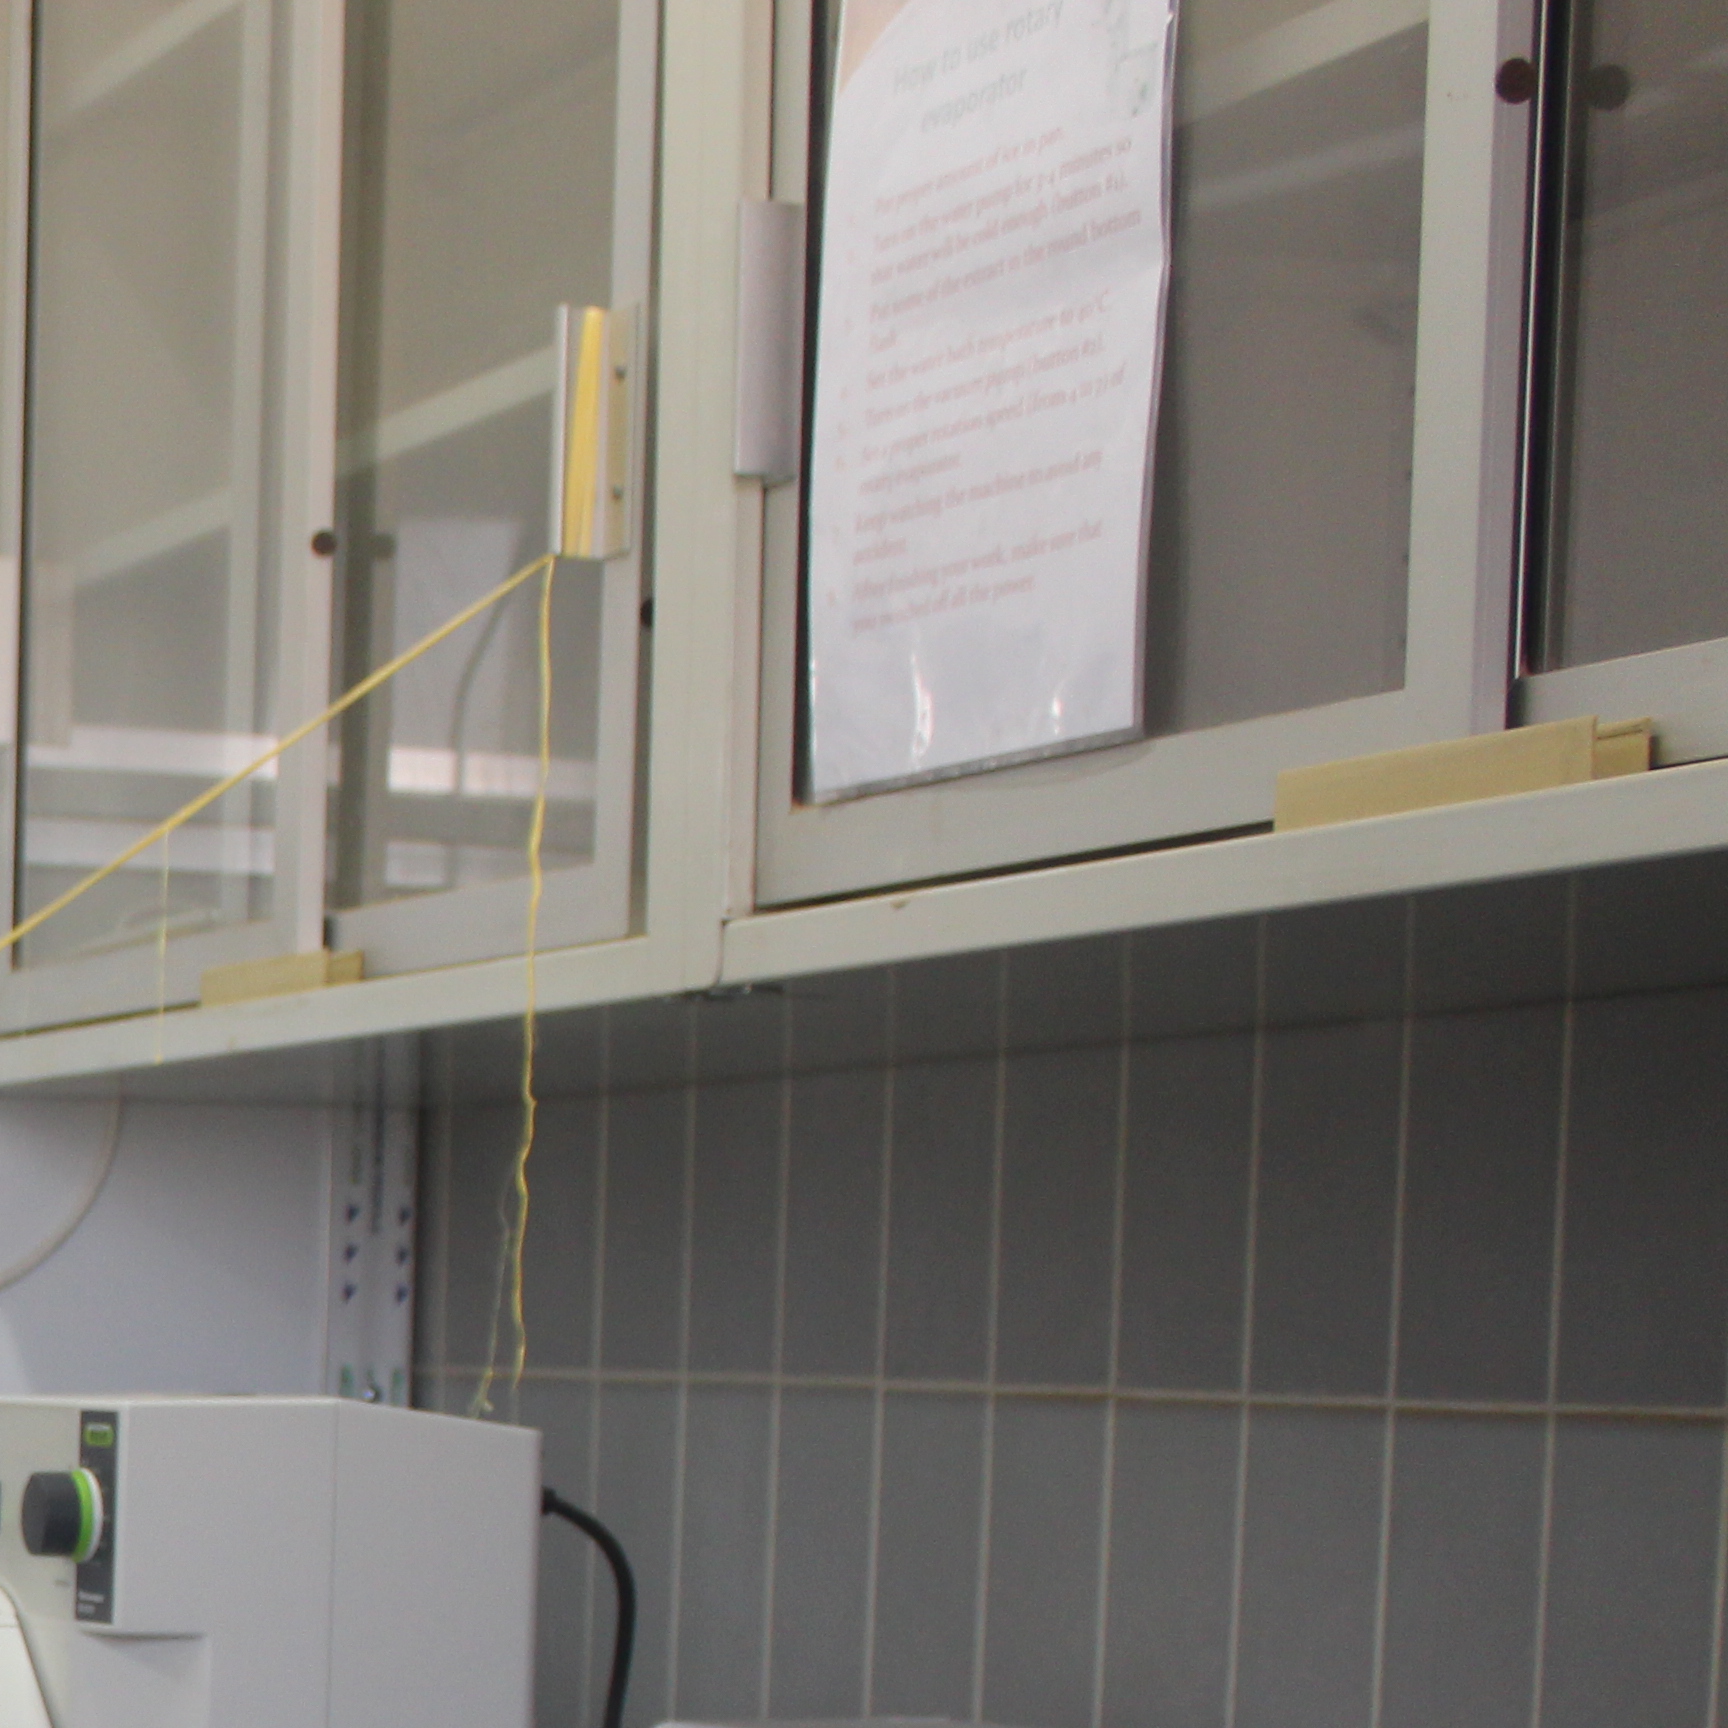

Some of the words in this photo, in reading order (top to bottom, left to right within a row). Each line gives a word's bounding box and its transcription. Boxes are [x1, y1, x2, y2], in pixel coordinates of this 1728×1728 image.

[893, 59, 936, 94] How
[967, 36, 999, 63] use
[1006, 0, 1064, 42] rotary
[920, 68, 1027, 134] evaporator
